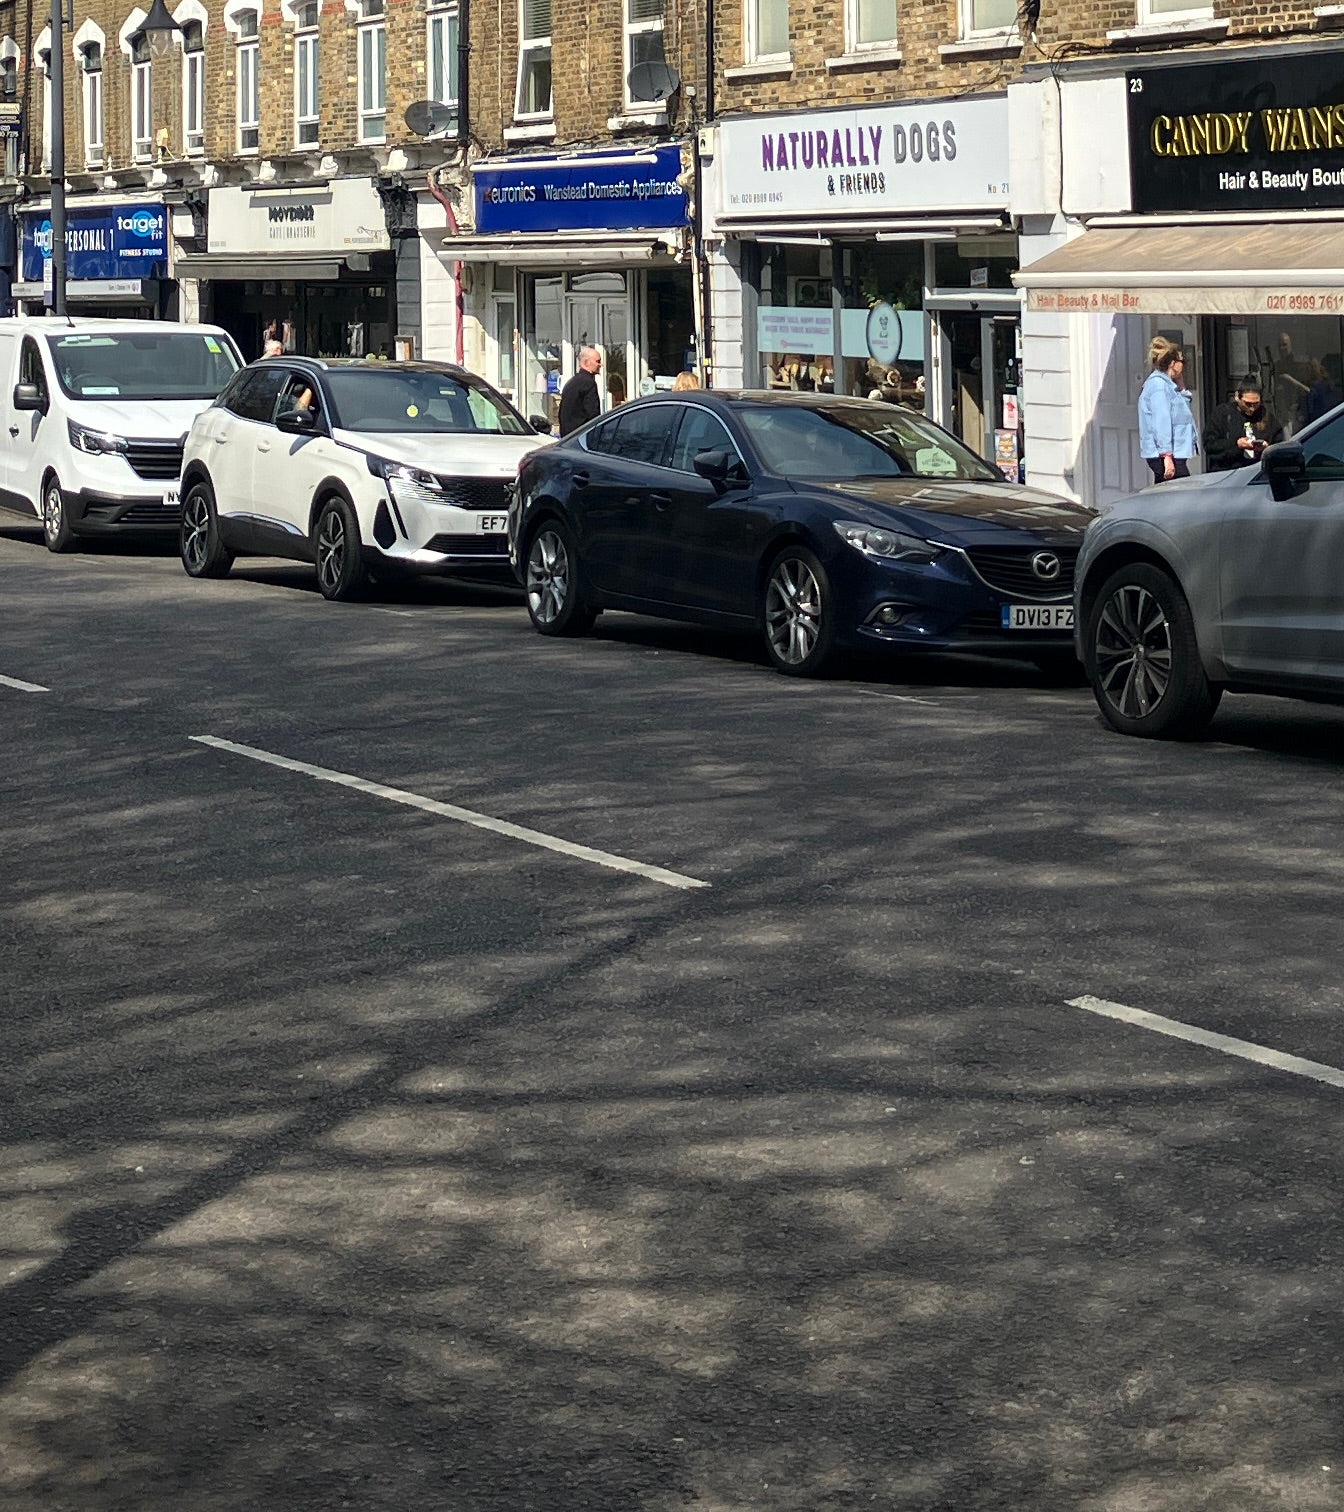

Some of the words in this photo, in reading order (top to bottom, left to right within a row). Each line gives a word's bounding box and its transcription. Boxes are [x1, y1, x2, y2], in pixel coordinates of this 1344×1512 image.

[1130, 78, 1143, 93] 23
[1151, 110, 1253, 157] CANDY
[762, 126, 883, 171] NATURALLY
[893, 120, 957, 164] DOGS
[544, 182, 587, 201] Wanstead
[588, 180, 630, 200] Domestic
[631, 178, 683, 201] Appliances
[827, 175, 836, 196] &
[839, 172, 886, 194] FRIENDS
[1219, 172, 1247, 190] Hair
[1248, 171, 1259, 188] &
[1262, 169, 1309, 192] Beauty
[492, 181, 535, 203] euronics
[117, 214, 163, 233] target
[151, 230, 163, 241] fit
[119, 249, 141, 257] FITNESS
[143, 248, 163, 256] STUDIO
[1037, 294, 1054, 307] Hair
[1057, 294, 1089, 310] Beauty
[1091, 294, 1098, 307] &
[1101, 294, 1120, 307] Nail
[1122, 294, 1139, 307] Bar
[1267, 295, 1286, 310] 020
[1289, 295, 1316, 310] 8989
[1319, 295, 1344, 310] 7611
[1016, 608, 1051, 626] DV13
